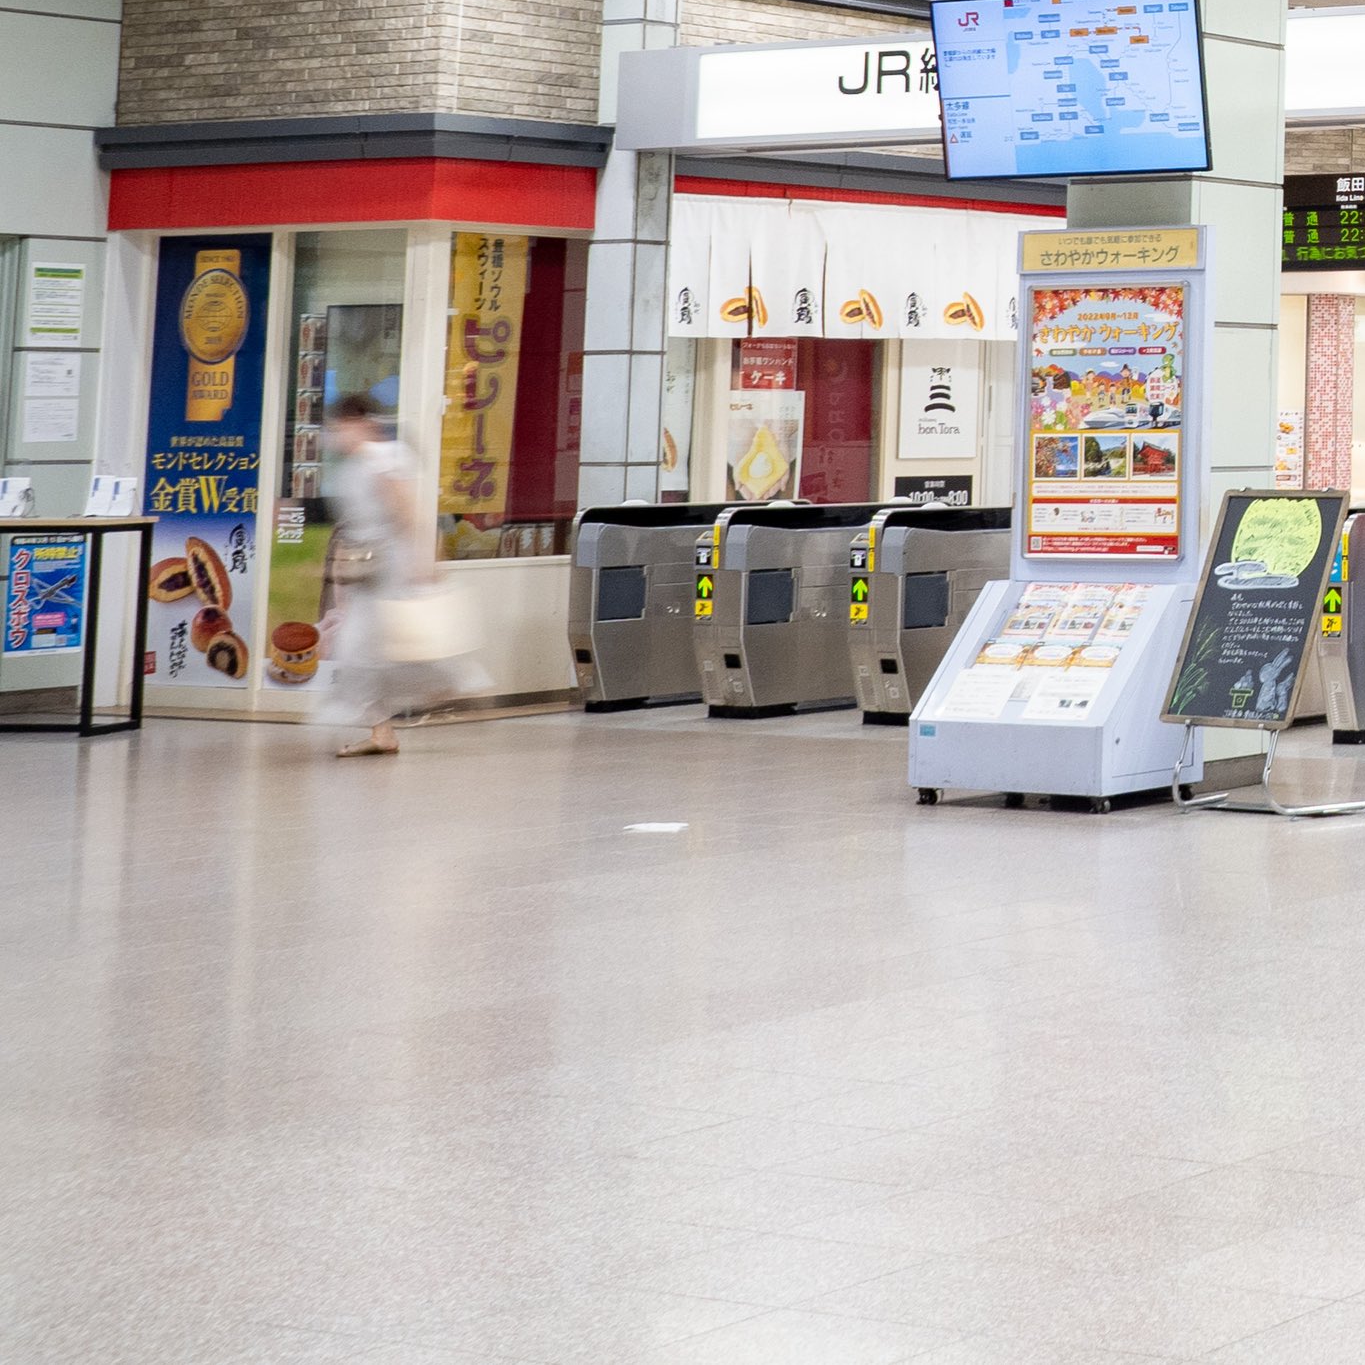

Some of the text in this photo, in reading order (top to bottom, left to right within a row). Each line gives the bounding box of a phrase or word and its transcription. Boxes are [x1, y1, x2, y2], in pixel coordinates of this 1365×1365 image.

[958, 12, 980, 27] JR
[1349, 194, 1364, 202] Line
[1283, 211, 1319, 226] 普通
[1284, 228, 1320, 243] 普通
[1040, 245, 1180, 267] さわやかウォーキング
[191, 371, 229, 387] GOLD
[750, 369, 787, 386] ケーキ
[455, 317, 512, 501] ピレーネ
[918, 421, 961, 435] bon Tora
[152, 451, 260, 472] モンドセレクション
[150, 475, 259, 514] 金賞W受賞
[9, 548, 32, 649] クロスボウ
